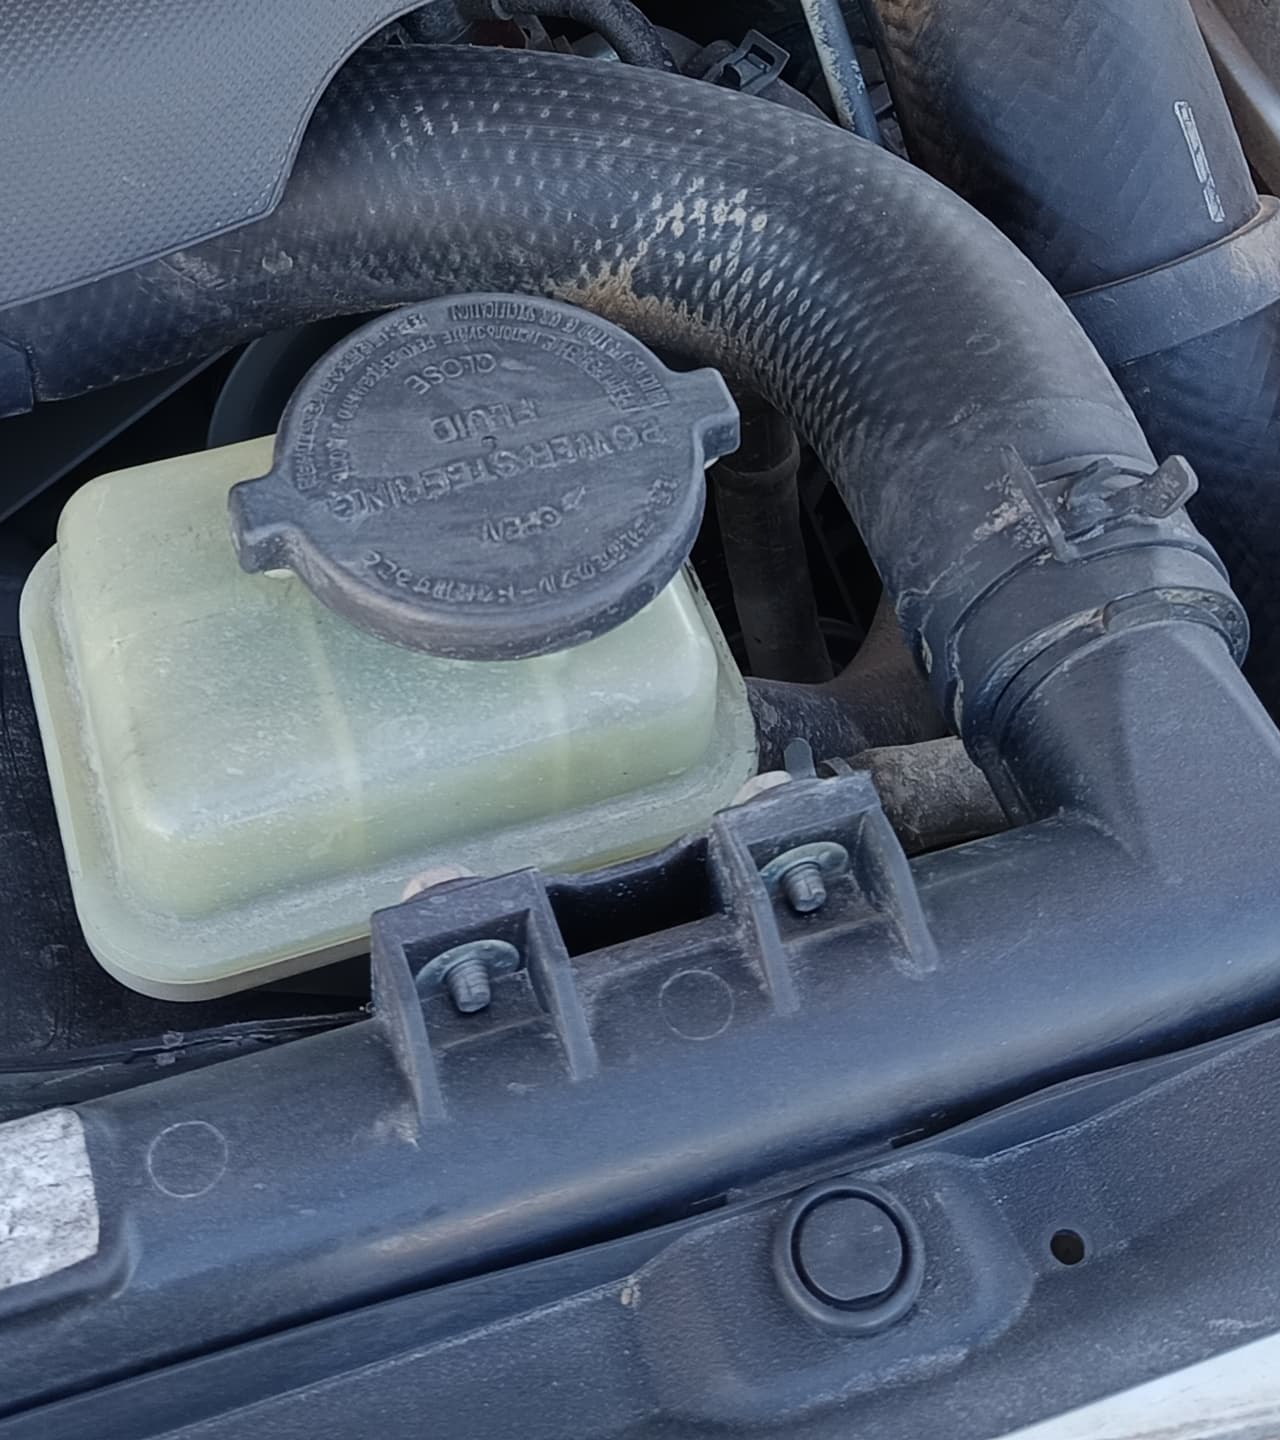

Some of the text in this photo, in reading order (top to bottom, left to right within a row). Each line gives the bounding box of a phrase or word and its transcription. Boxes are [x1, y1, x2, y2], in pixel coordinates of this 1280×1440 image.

[430, 398, 540, 444] FLUID
[327, 421, 666, 524] POWER STEERING
